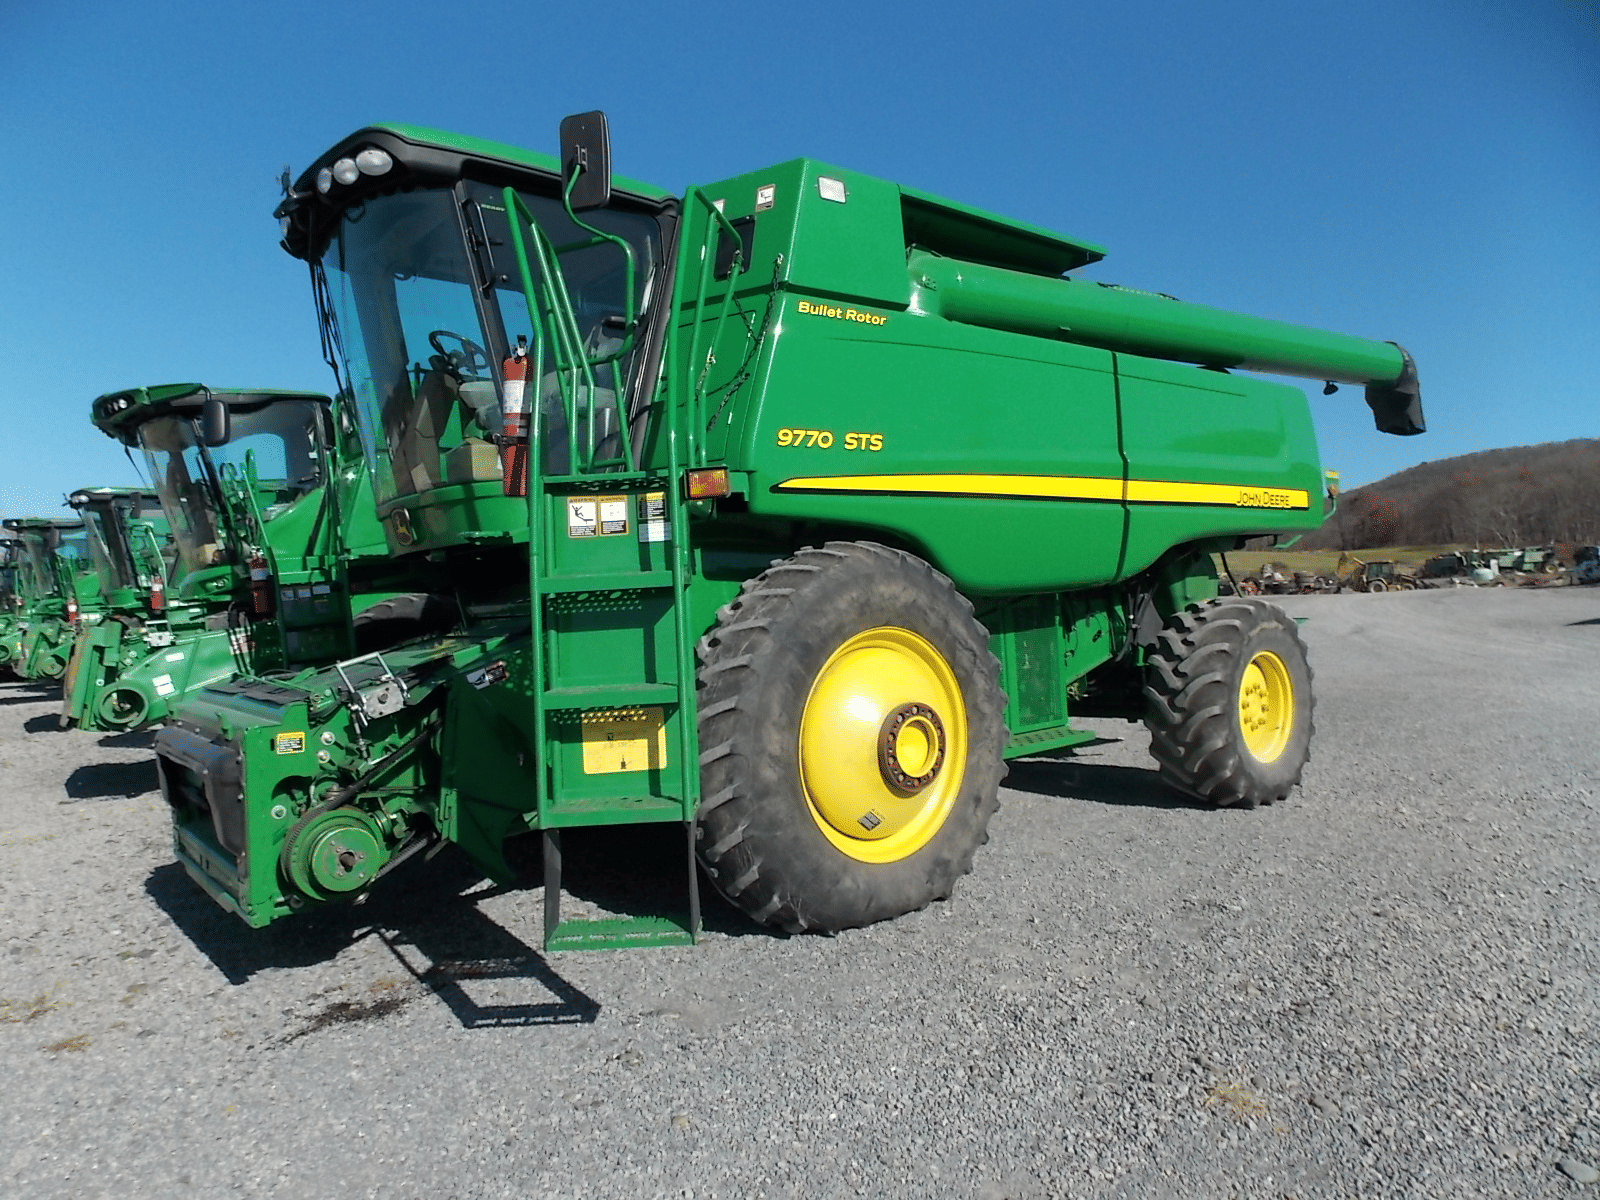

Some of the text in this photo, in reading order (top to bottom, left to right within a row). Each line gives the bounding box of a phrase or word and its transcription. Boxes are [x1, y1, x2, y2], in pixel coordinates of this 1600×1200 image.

[798, 302, 887, 325] Bullet Rotor
[777, 428, 884, 451] 9770 STS
[1236, 491, 1290, 506] JOHN DEERE
